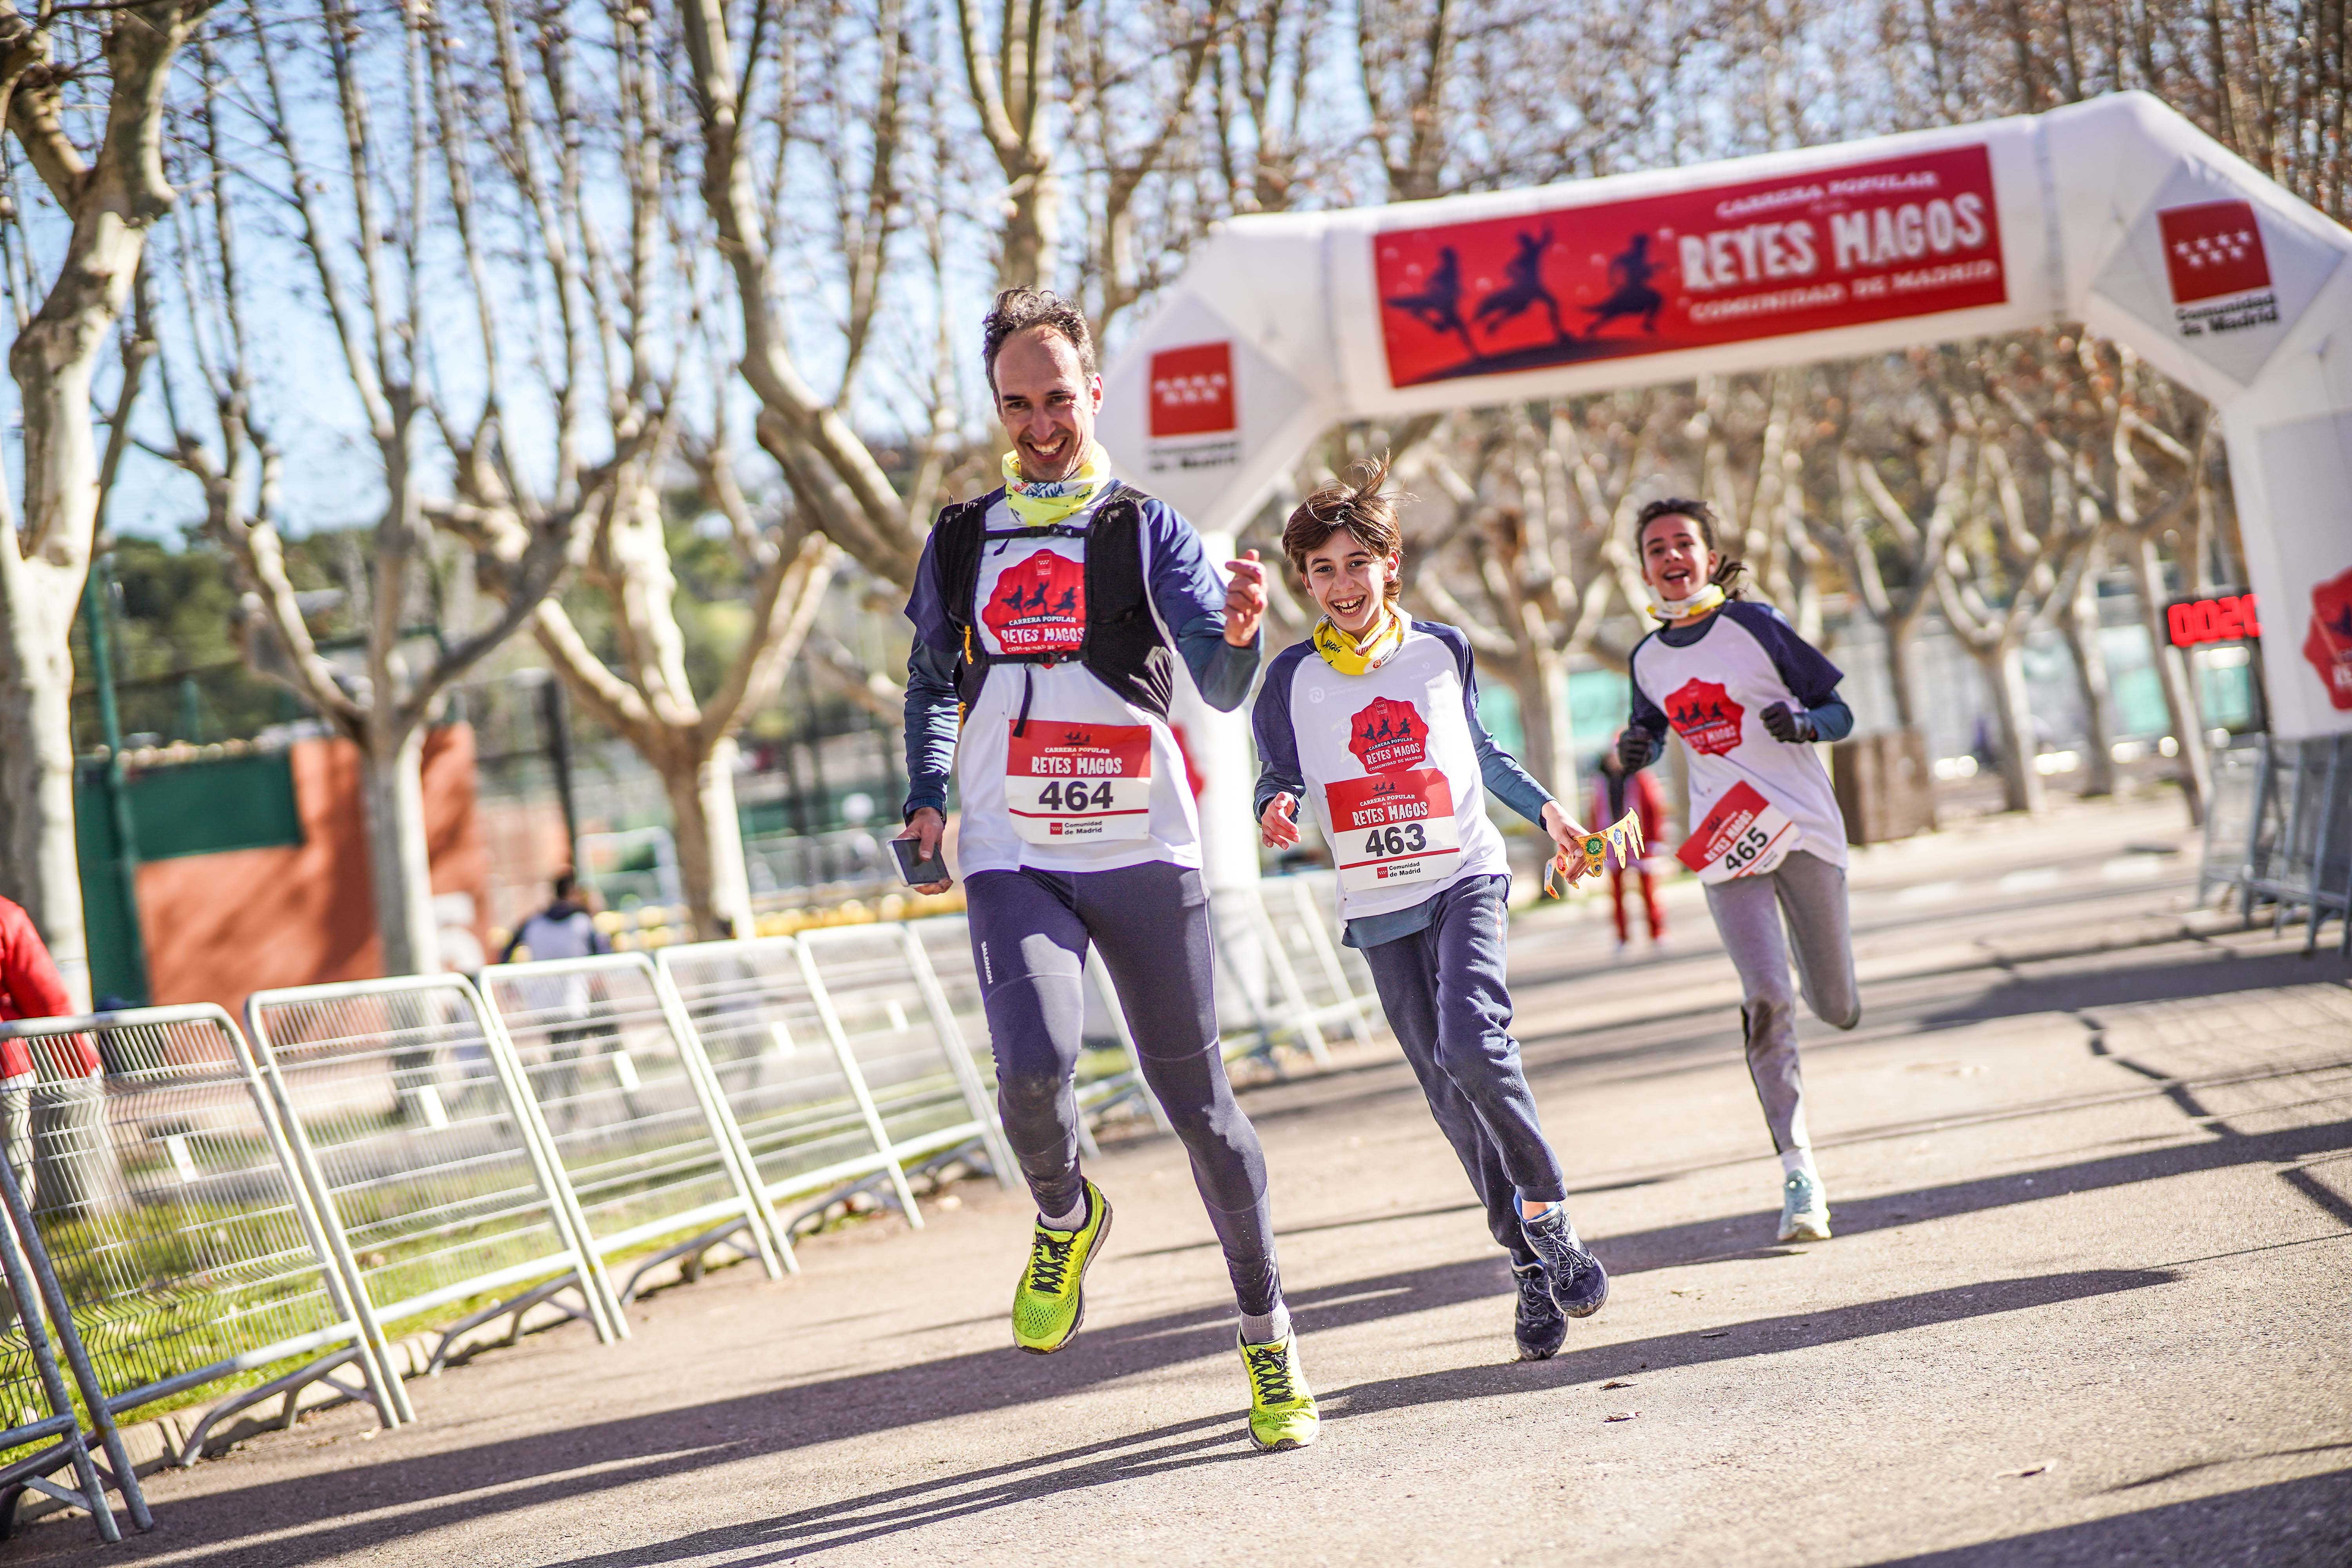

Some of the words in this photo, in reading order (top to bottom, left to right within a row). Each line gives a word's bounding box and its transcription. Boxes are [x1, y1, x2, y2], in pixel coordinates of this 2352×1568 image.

[1678, 221, 1818, 291] REYES
[1830, 192, 1987, 270] MAGOS
[1009, 617, 1040, 626] CARRERA
[1044, 627, 1085, 642] MAGOS
[1366, 749, 1392, 765] REYES
[1393, 742, 1421, 758] MAGOS
[1369, 741, 1390, 751] CARRERA
[1031, 757, 1071, 774] REYES
[1077, 757, 1122, 775] MAGOS
[1369, 760, 1396, 771] COMUNIDAD
[1039, 781, 1113, 811] 464
[1360, 797, 1385, 806] CARRERA
[1352, 808, 1385, 826] REYES
[1388, 801, 1428, 821] MAGOS
[1365, 823, 1426, 857] 463
[1726, 826, 1768, 869] 465
[1389, 862, 1420, 870] Comunidad
[1399, 867, 1421, 876] Madrid
[981, 941, 993, 985] SALOMON
